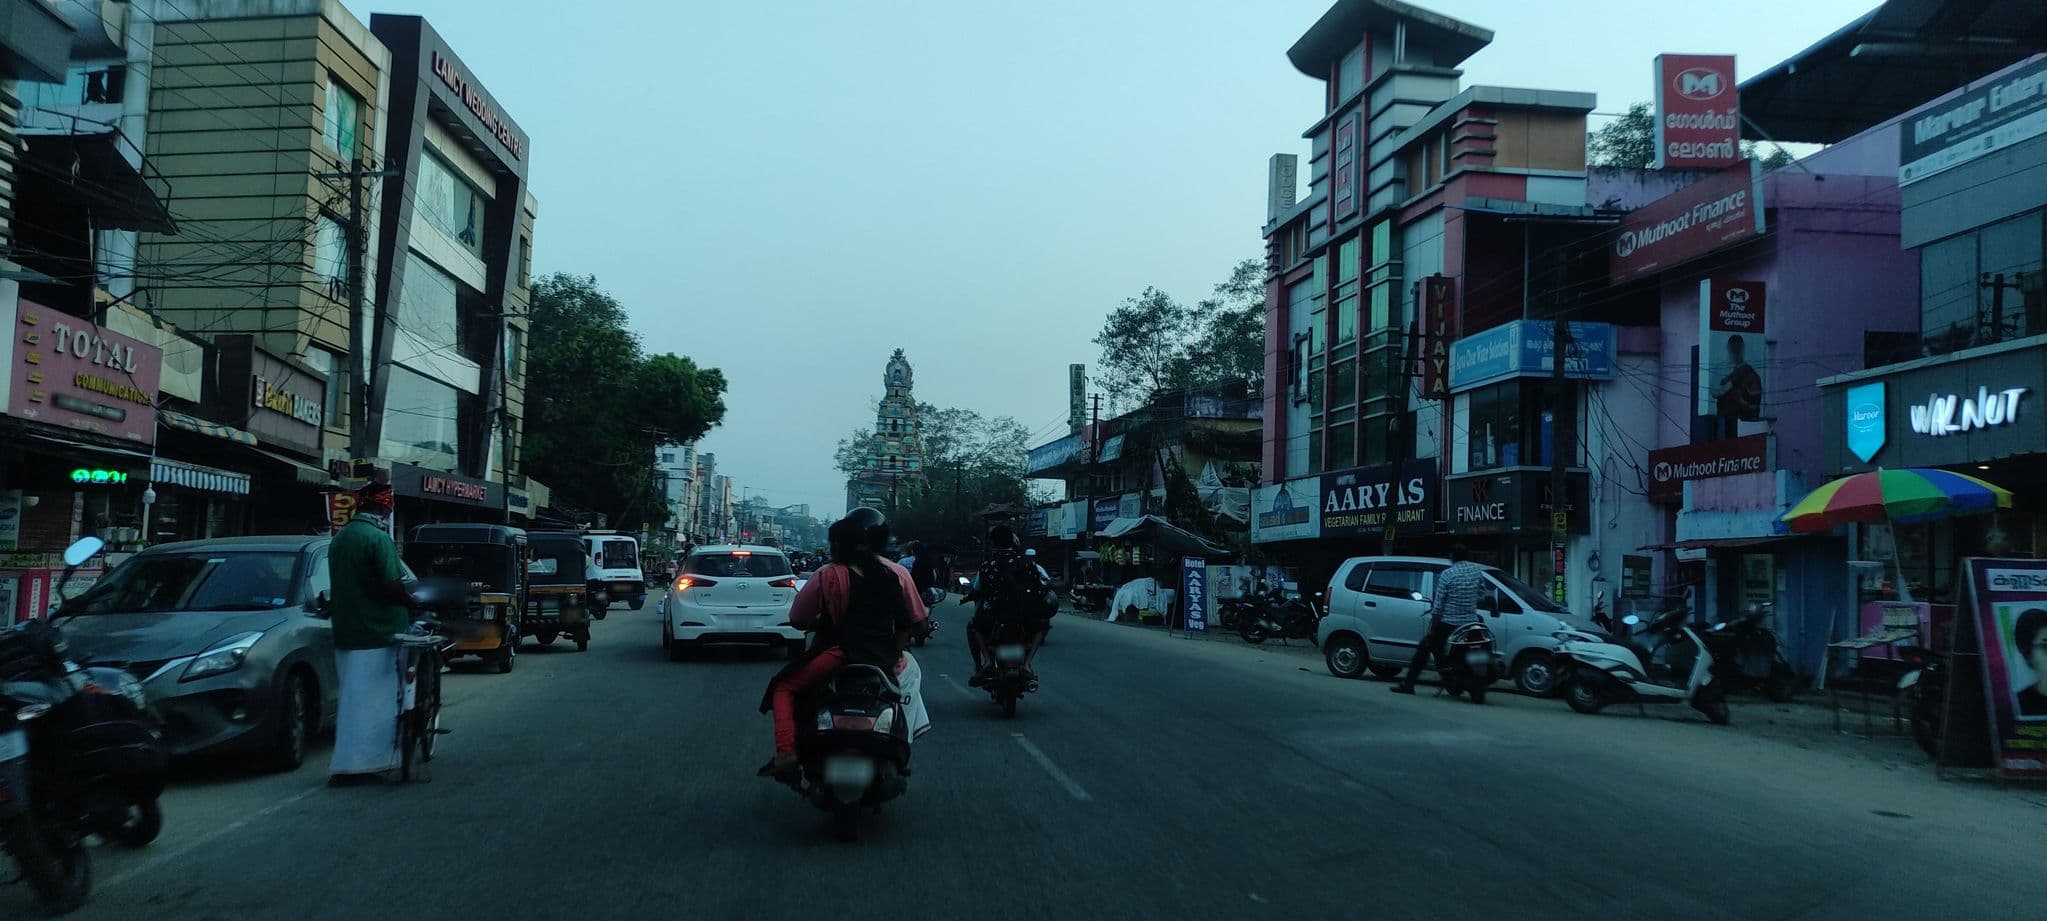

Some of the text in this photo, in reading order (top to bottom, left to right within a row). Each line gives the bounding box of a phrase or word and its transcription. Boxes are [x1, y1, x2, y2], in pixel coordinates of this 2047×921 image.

[433, 51, 521, 161] LAMCY WEDDING CENTRE
[1637, 212, 1689, 249] Muthoot
[1692, 189, 1746, 226] Finance
[1719, 310, 1755, 320] Muthoot
[1730, 303, 1745, 312] The
[1724, 319, 1750, 328] Group
[53, 322, 137, 374] TOTAL
[1432, 284, 1447, 394] VIJAYA
[1911, 385, 2031, 436] WALNUT
[1673, 459, 1716, 479] Muthoot
[1718, 455, 1760, 473] Finance
[424, 475, 446, 493] LAMCY
[447, 480, 487, 500] HYPERMARKET
[1324, 477, 1425, 513] AARYAS
[1324, 515, 1359, 528] VEGETARIAN
[1360, 512, 1381, 525] FAMILY
[1457, 502, 1505, 522] FINANCE
[1184, 558, 1205, 569] Hotel
[1187, 570, 1203, 619] AARYAS
[1187, 619, 1205, 631] Veg
